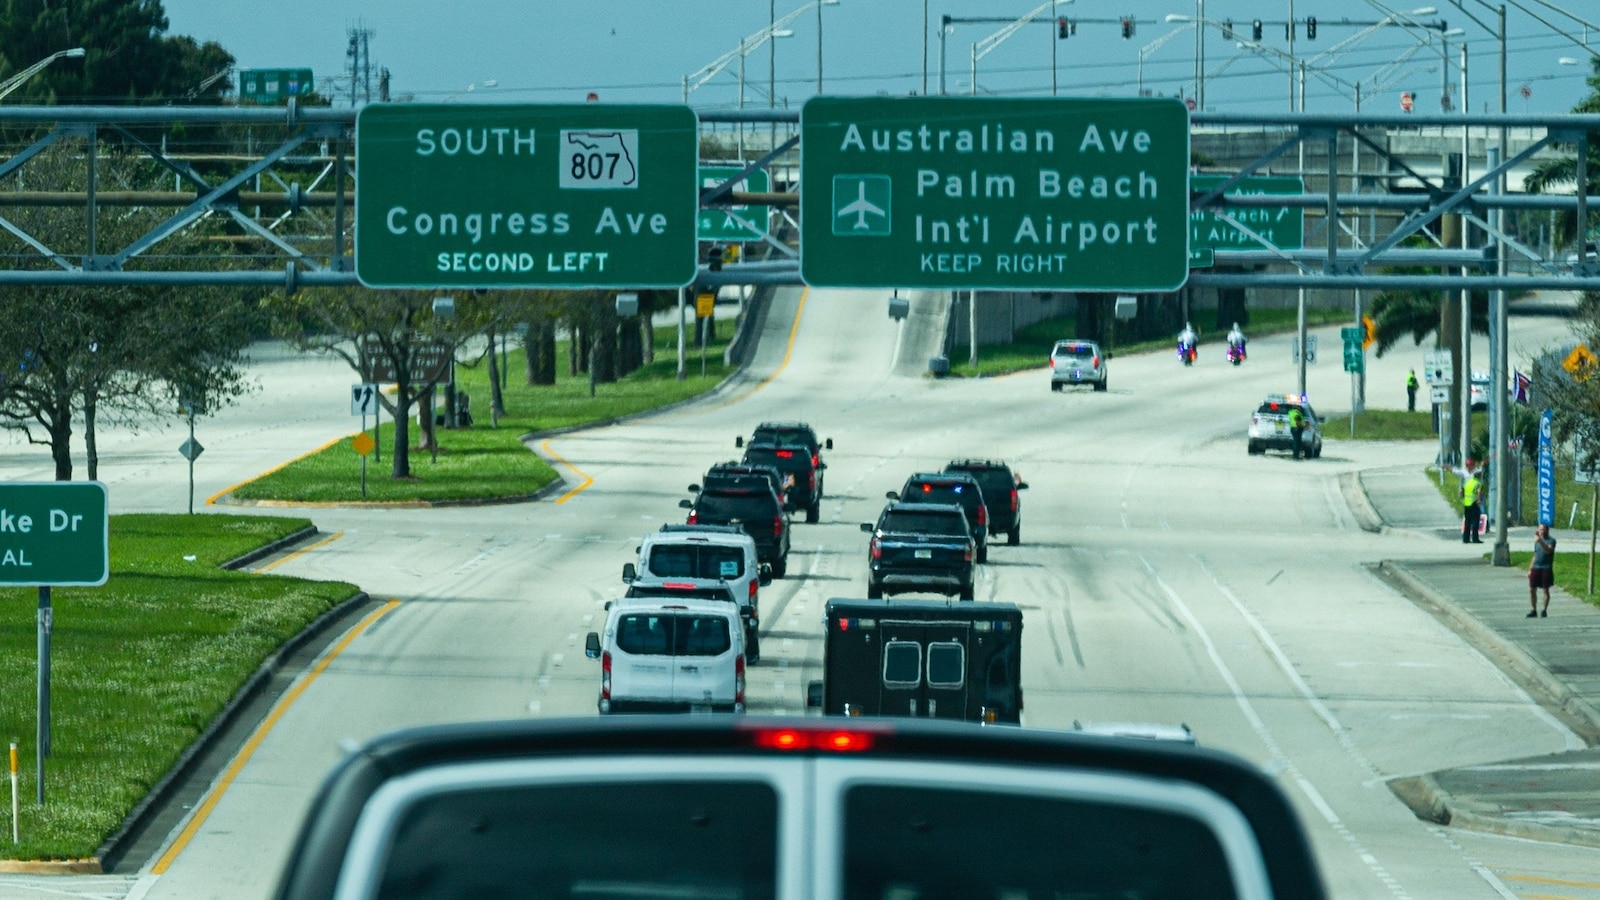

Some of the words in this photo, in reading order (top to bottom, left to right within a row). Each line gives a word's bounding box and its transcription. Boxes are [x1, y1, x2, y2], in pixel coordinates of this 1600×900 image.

[416, 128, 536, 156] SOUTH
[840, 123, 1055, 152] Australian
[1079, 124, 1152, 153] Ave
[571, 152, 620, 180] 807
[916, 169, 1016, 198] Palm
[1037, 170, 1158, 198] Beach
[386, 206, 570, 242] Congress
[595, 207, 668, 234] Ave
[1214, 208, 1269, 221] each
[915, 215, 990, 244] Int'l
[1014, 215, 1158, 250] Airport
[1208, 227, 1274, 243] Airprt
[436, 252, 535, 273] SECOND
[547, 251, 608, 273] LEFT
[920, 253, 982, 273] KEEP
[996, 253, 1067, 273] RIGHT
[49, 508, 83, 532] Dr
[1, 549, 33, 566] AL
